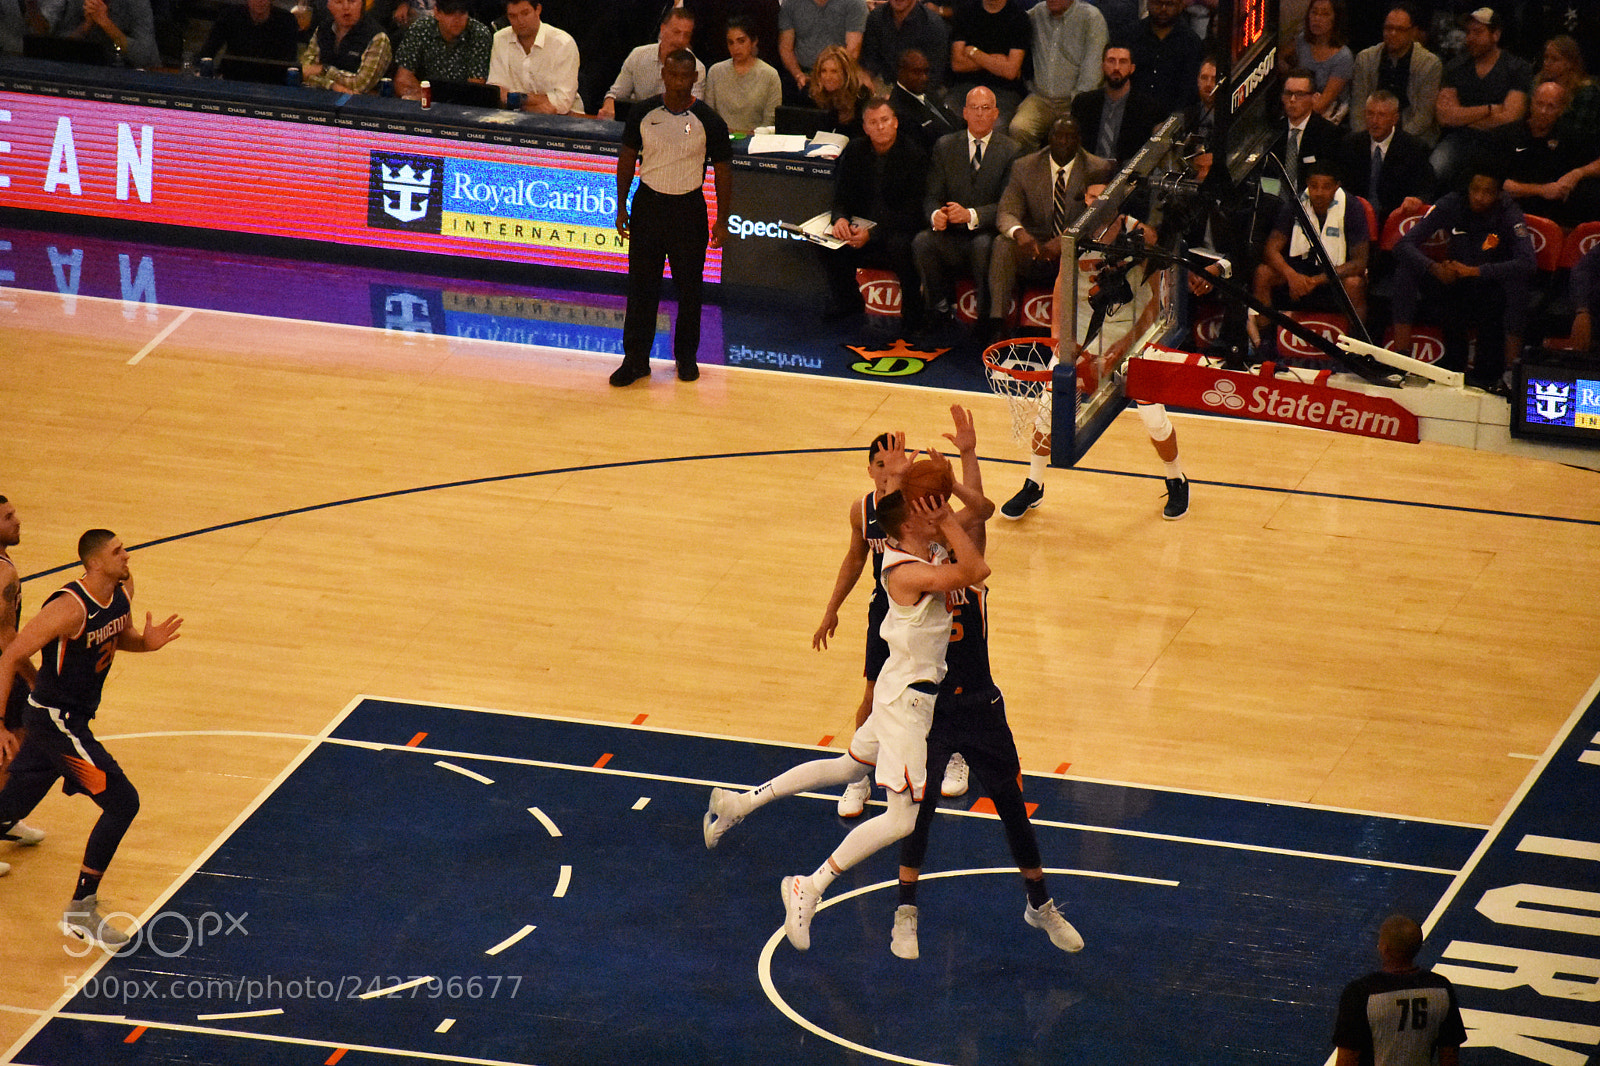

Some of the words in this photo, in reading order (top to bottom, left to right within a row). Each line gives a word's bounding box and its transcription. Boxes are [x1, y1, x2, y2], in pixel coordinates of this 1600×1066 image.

[1244, 47, 1277, 98] TISSOT
[121, 95, 140, 103] CHASE
[148, 98, 166, 106] CHASE
[174, 101, 193, 109] CHASE
[202, 104, 220, 112] CHASE
[308, 115, 326, 123] CHASE
[334, 118, 353, 126] CHASE
[360, 121, 379, 129] CHASE
[387, 124, 406, 132] CHASE
[494, 135, 512, 143] CHASE
[520, 138, 538, 146] CHASE
[573, 143, 591, 151] CHASE
[600, 146, 618, 154] CHASE
[732, 159, 751, 167] CHASE
[759, 162, 777, 170] CHASE
[1396, 997, 1428, 1032] 76
